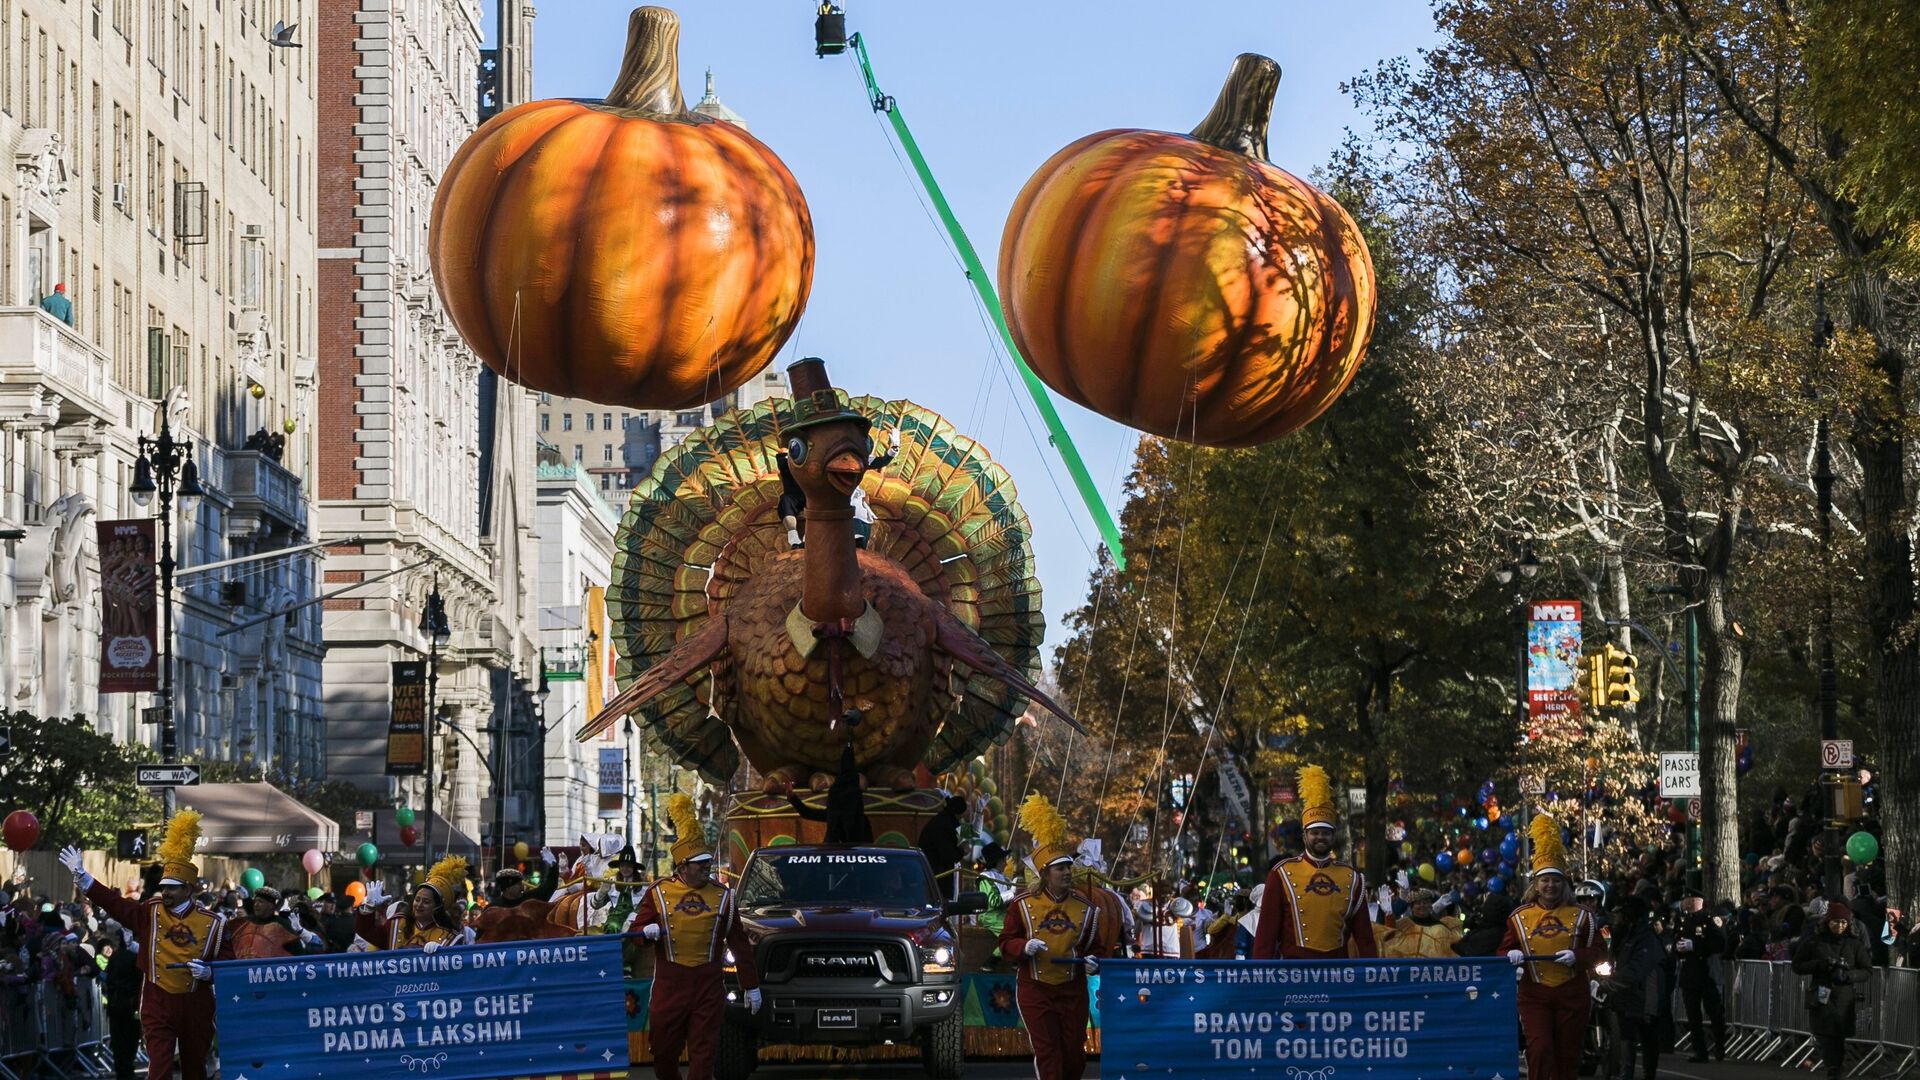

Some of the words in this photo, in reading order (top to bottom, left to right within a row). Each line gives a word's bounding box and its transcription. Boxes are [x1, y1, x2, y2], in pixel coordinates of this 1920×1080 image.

[114, 526, 138, 535] NYC
[1534, 605, 1575, 620] NYC
[394, 685, 424, 697] VIET
[1533, 693, 1548, 701] SEE
[394, 698, 423, 709] NAM
[393, 710, 423, 722] WAR
[142, 772, 160, 780] ONE
[171, 771, 192, 780] WAY
[1665, 776, 1691, 788] CARS
[275, 834, 291, 847] 145
[788, 855, 821, 864] RAM
[826, 855, 887, 864] TRUCKS
[248, 962, 316, 984] MACY'S
[325, 954, 463, 978] THANKSGIVING
[472, 951, 507, 969] DAY
[516, 945, 588, 966] PARADE
[807, 957, 867, 965] RAM
[1135, 965, 1206, 984] MACY'S
[1214, 967, 1355, 984] THANKSGIVING
[1365, 966, 1400, 983] DAY
[1410, 965, 1482, 982] PARADE
[308, 1001, 406, 1028] BRAVO'S
[417, 998, 463, 1021] TOP
[474, 993, 534, 1017] CHEF
[1194, 1011, 1294, 1033] BRAVO'S
[1306, 1011, 1352, 1033] TOP
[1364, 1010, 1425, 1032] CHEF
[323, 1027, 406, 1053] PADMA
[417, 1020, 521, 1047] LAKSHMI
[1211, 1038, 1262, 1060] TOM
[1276, 1037, 1408, 1060] COLICCHIO
